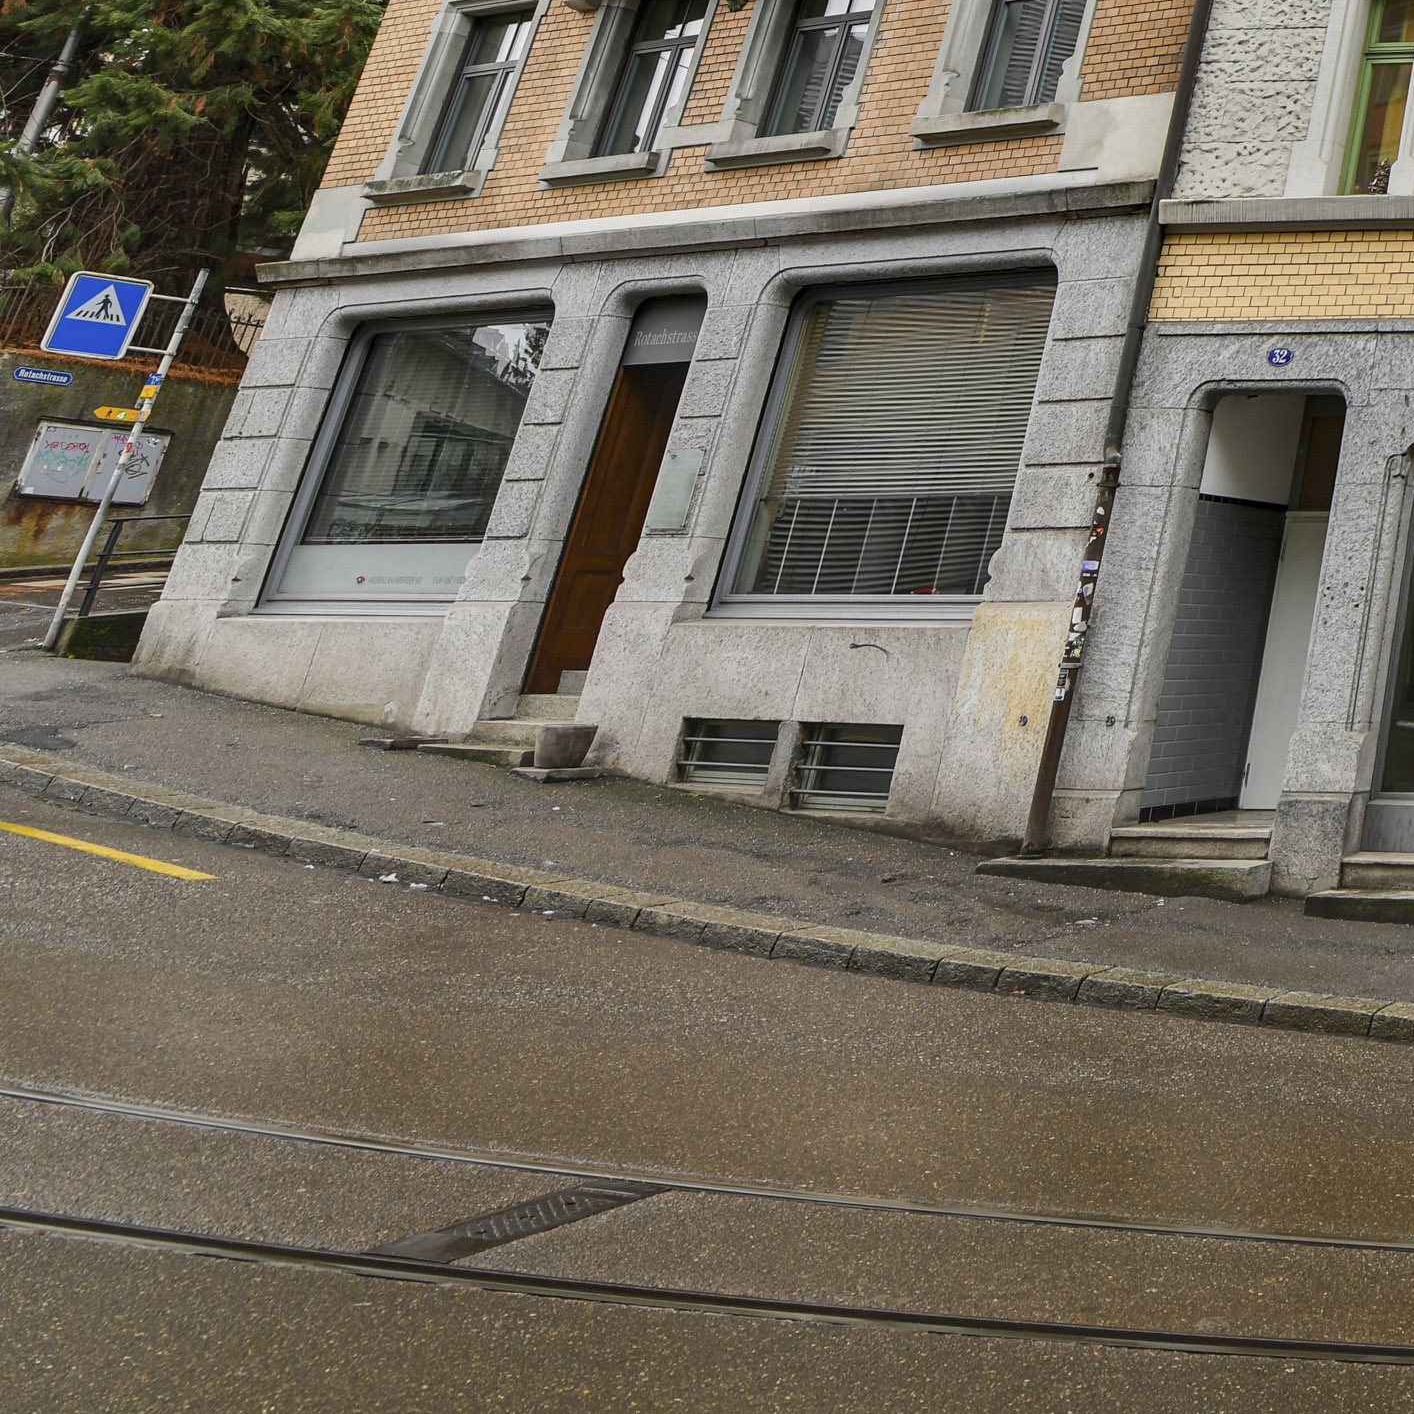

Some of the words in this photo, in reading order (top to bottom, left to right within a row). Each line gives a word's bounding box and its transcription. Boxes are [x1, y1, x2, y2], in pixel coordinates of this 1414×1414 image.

[633, 328, 698, 346] Rotachstrass
[1272, 349, 1288, 363] 32
[18, 369, 68, 382] Rotachstrasse
